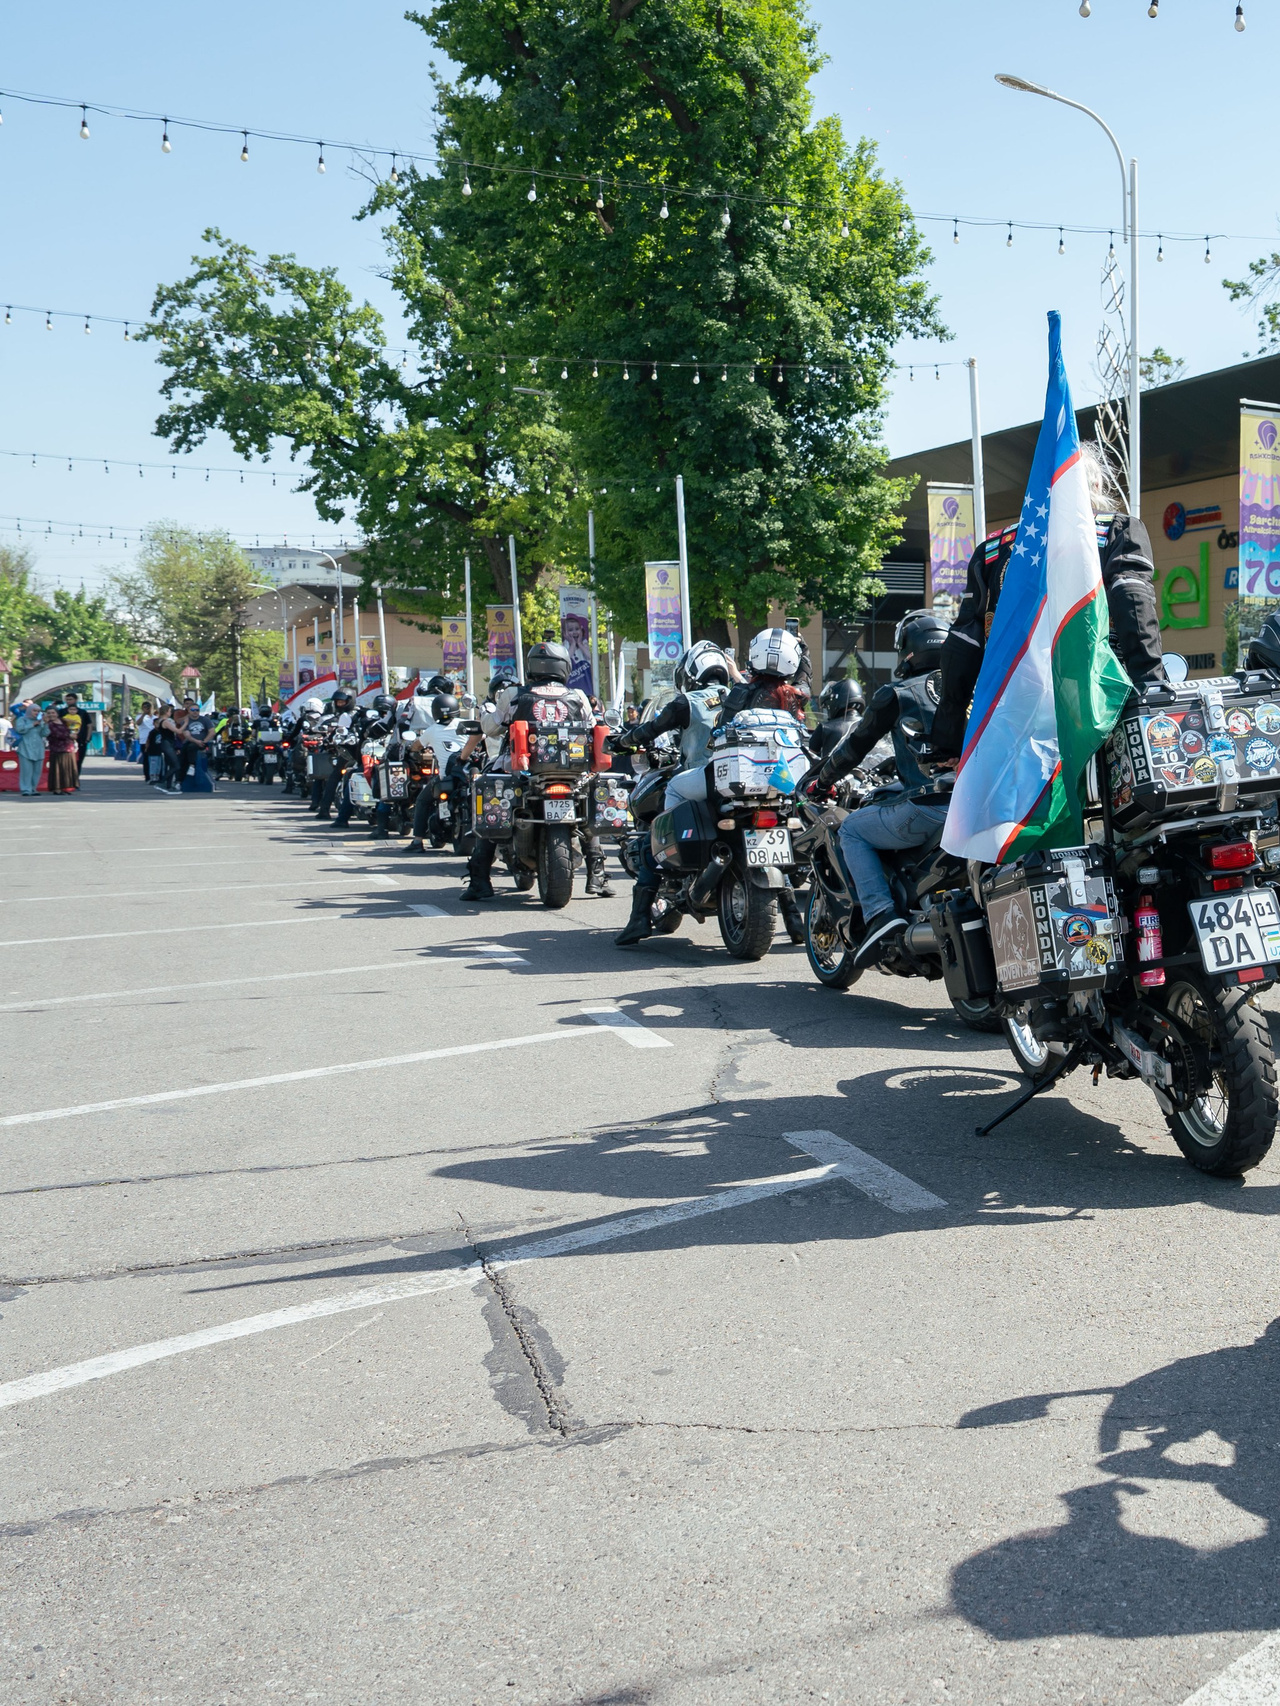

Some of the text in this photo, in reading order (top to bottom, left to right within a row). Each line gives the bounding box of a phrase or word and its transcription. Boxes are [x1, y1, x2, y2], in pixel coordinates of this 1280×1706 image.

[653, 641, 680, 659] 70
[1126, 721, 1149, 781] HONDA
[717, 764, 729, 778] GS
[767, 830, 786, 845] 39
[749, 850, 791, 864] 08 AH
[1051, 850, 1086, 860] HONDA
[1198, 899, 1276, 933] 484 01
[1032, 890, 1054, 965] HONDA
[1210, 934, 1256, 967] DA
